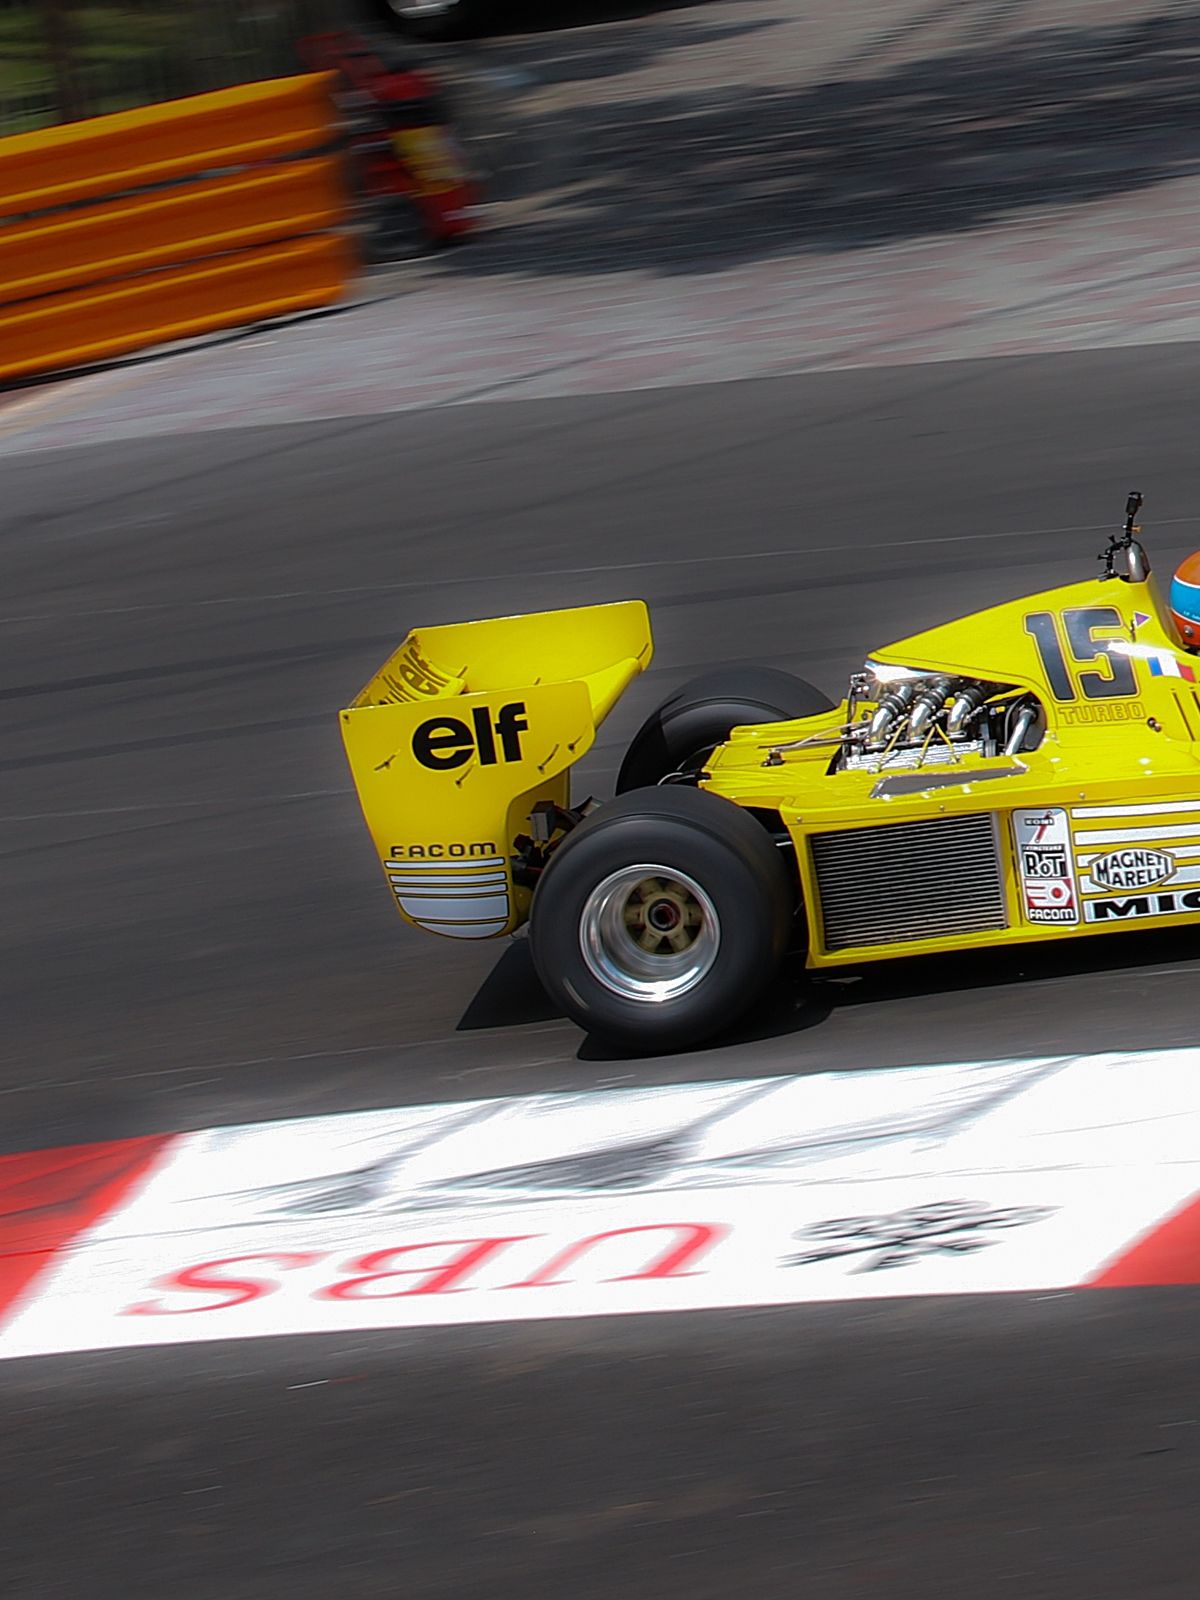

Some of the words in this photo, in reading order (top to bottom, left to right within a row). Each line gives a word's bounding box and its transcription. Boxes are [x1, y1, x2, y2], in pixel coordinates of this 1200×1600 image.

[1024, 607, 1139, 702] 15
[1058, 702, 1146, 724] TURBO
[412, 702, 529, 771] elf
[390, 842, 497, 858] FACOM
[1029, 908, 1074, 920] FACOM
[120, 1221, 729, 1316] UBS
